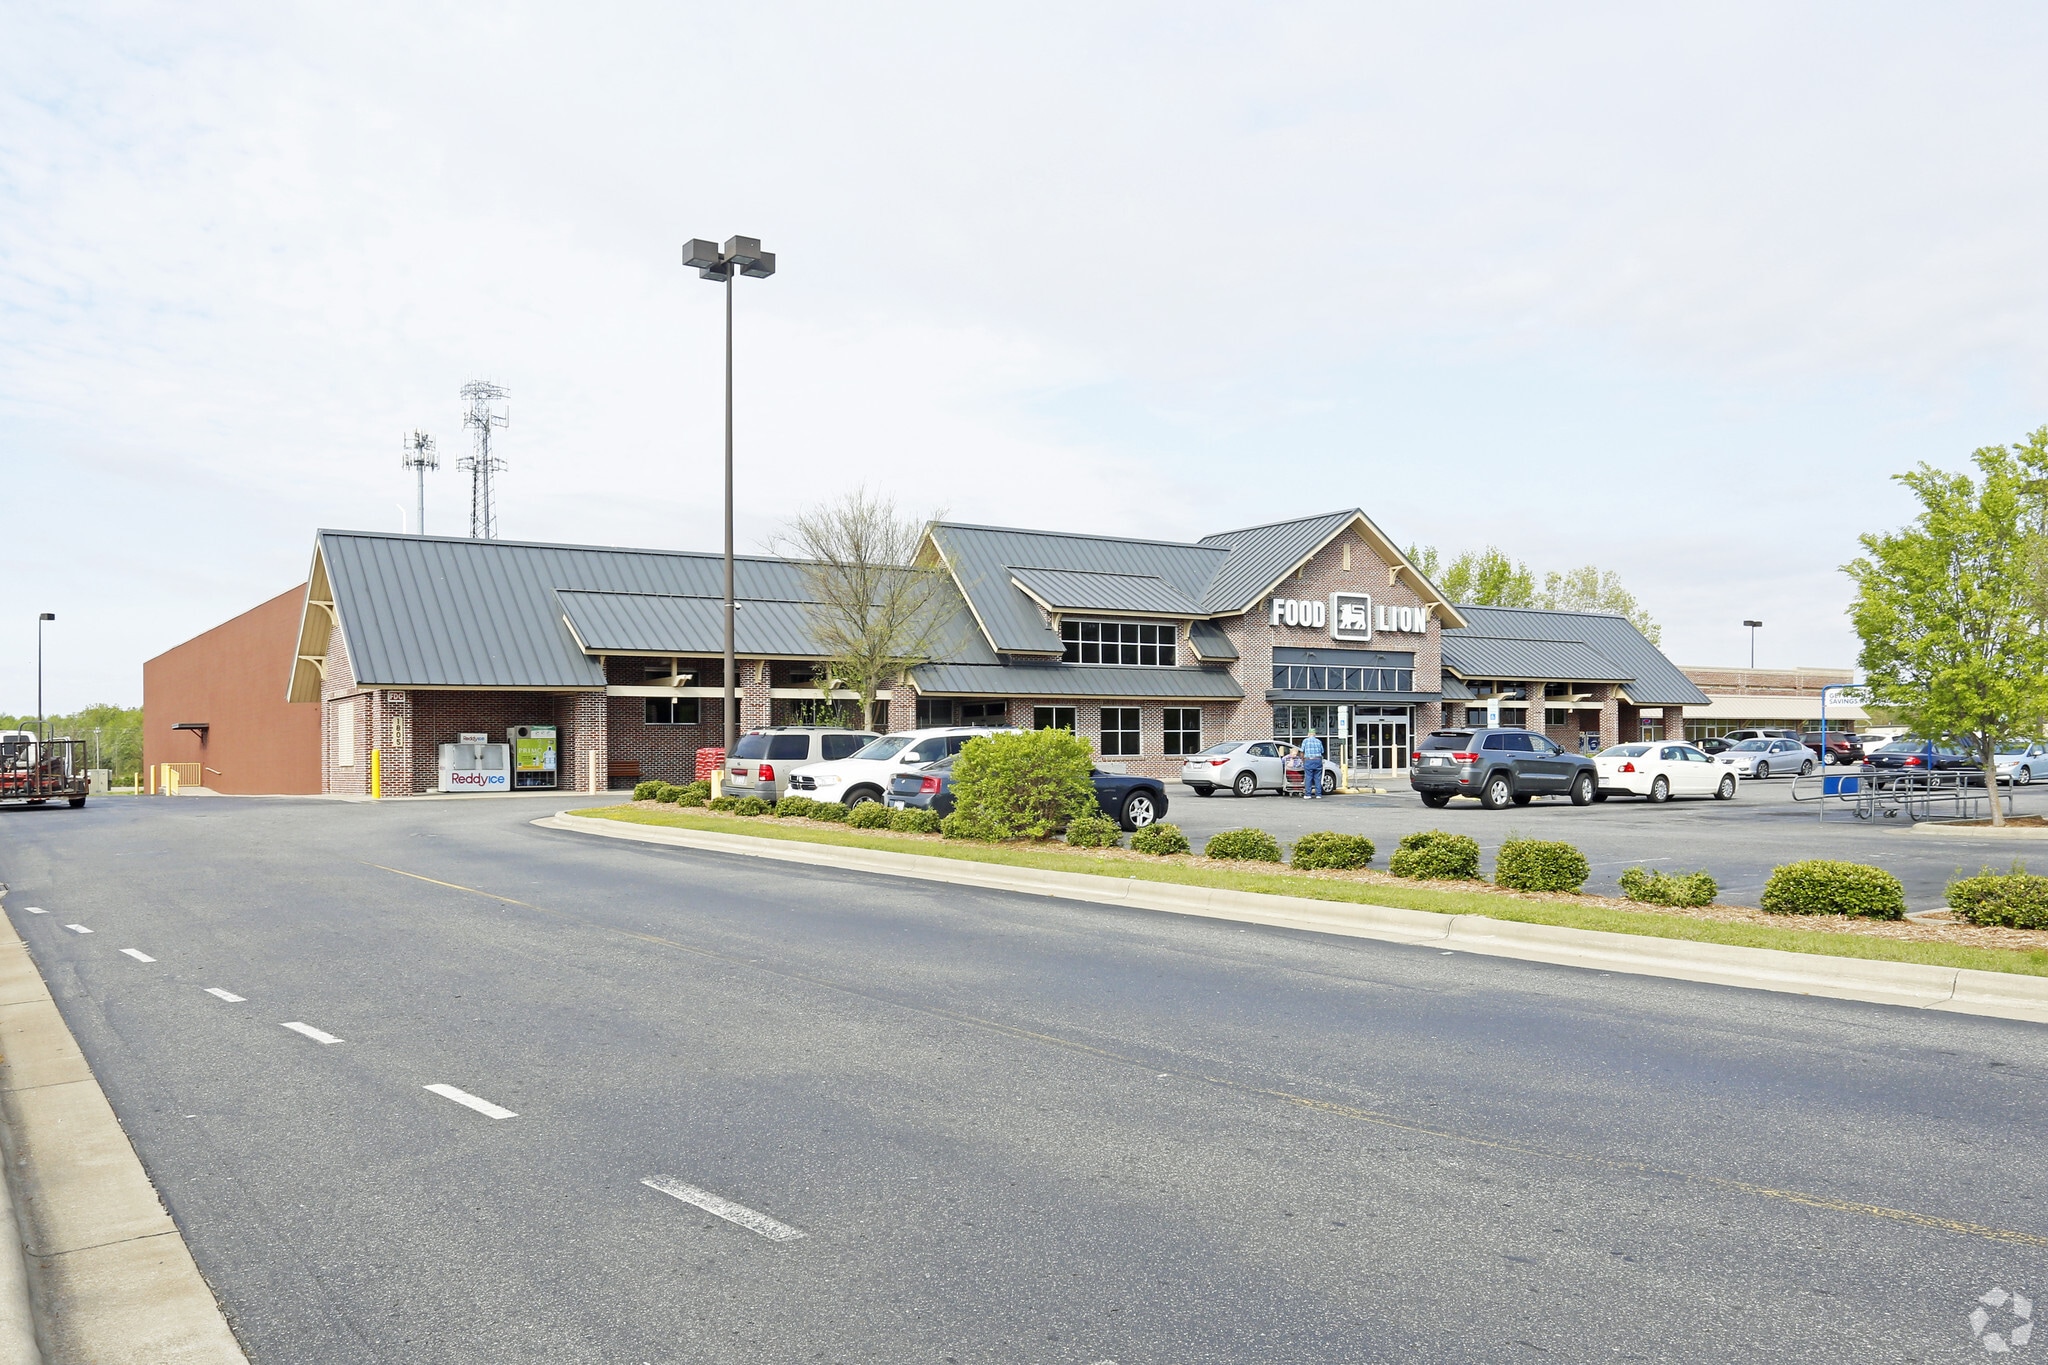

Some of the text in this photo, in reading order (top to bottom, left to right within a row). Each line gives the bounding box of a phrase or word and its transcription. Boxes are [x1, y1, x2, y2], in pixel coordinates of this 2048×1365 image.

[1270, 598, 1427, 633] FOOD LION
[390, 692, 403, 700] FDC
